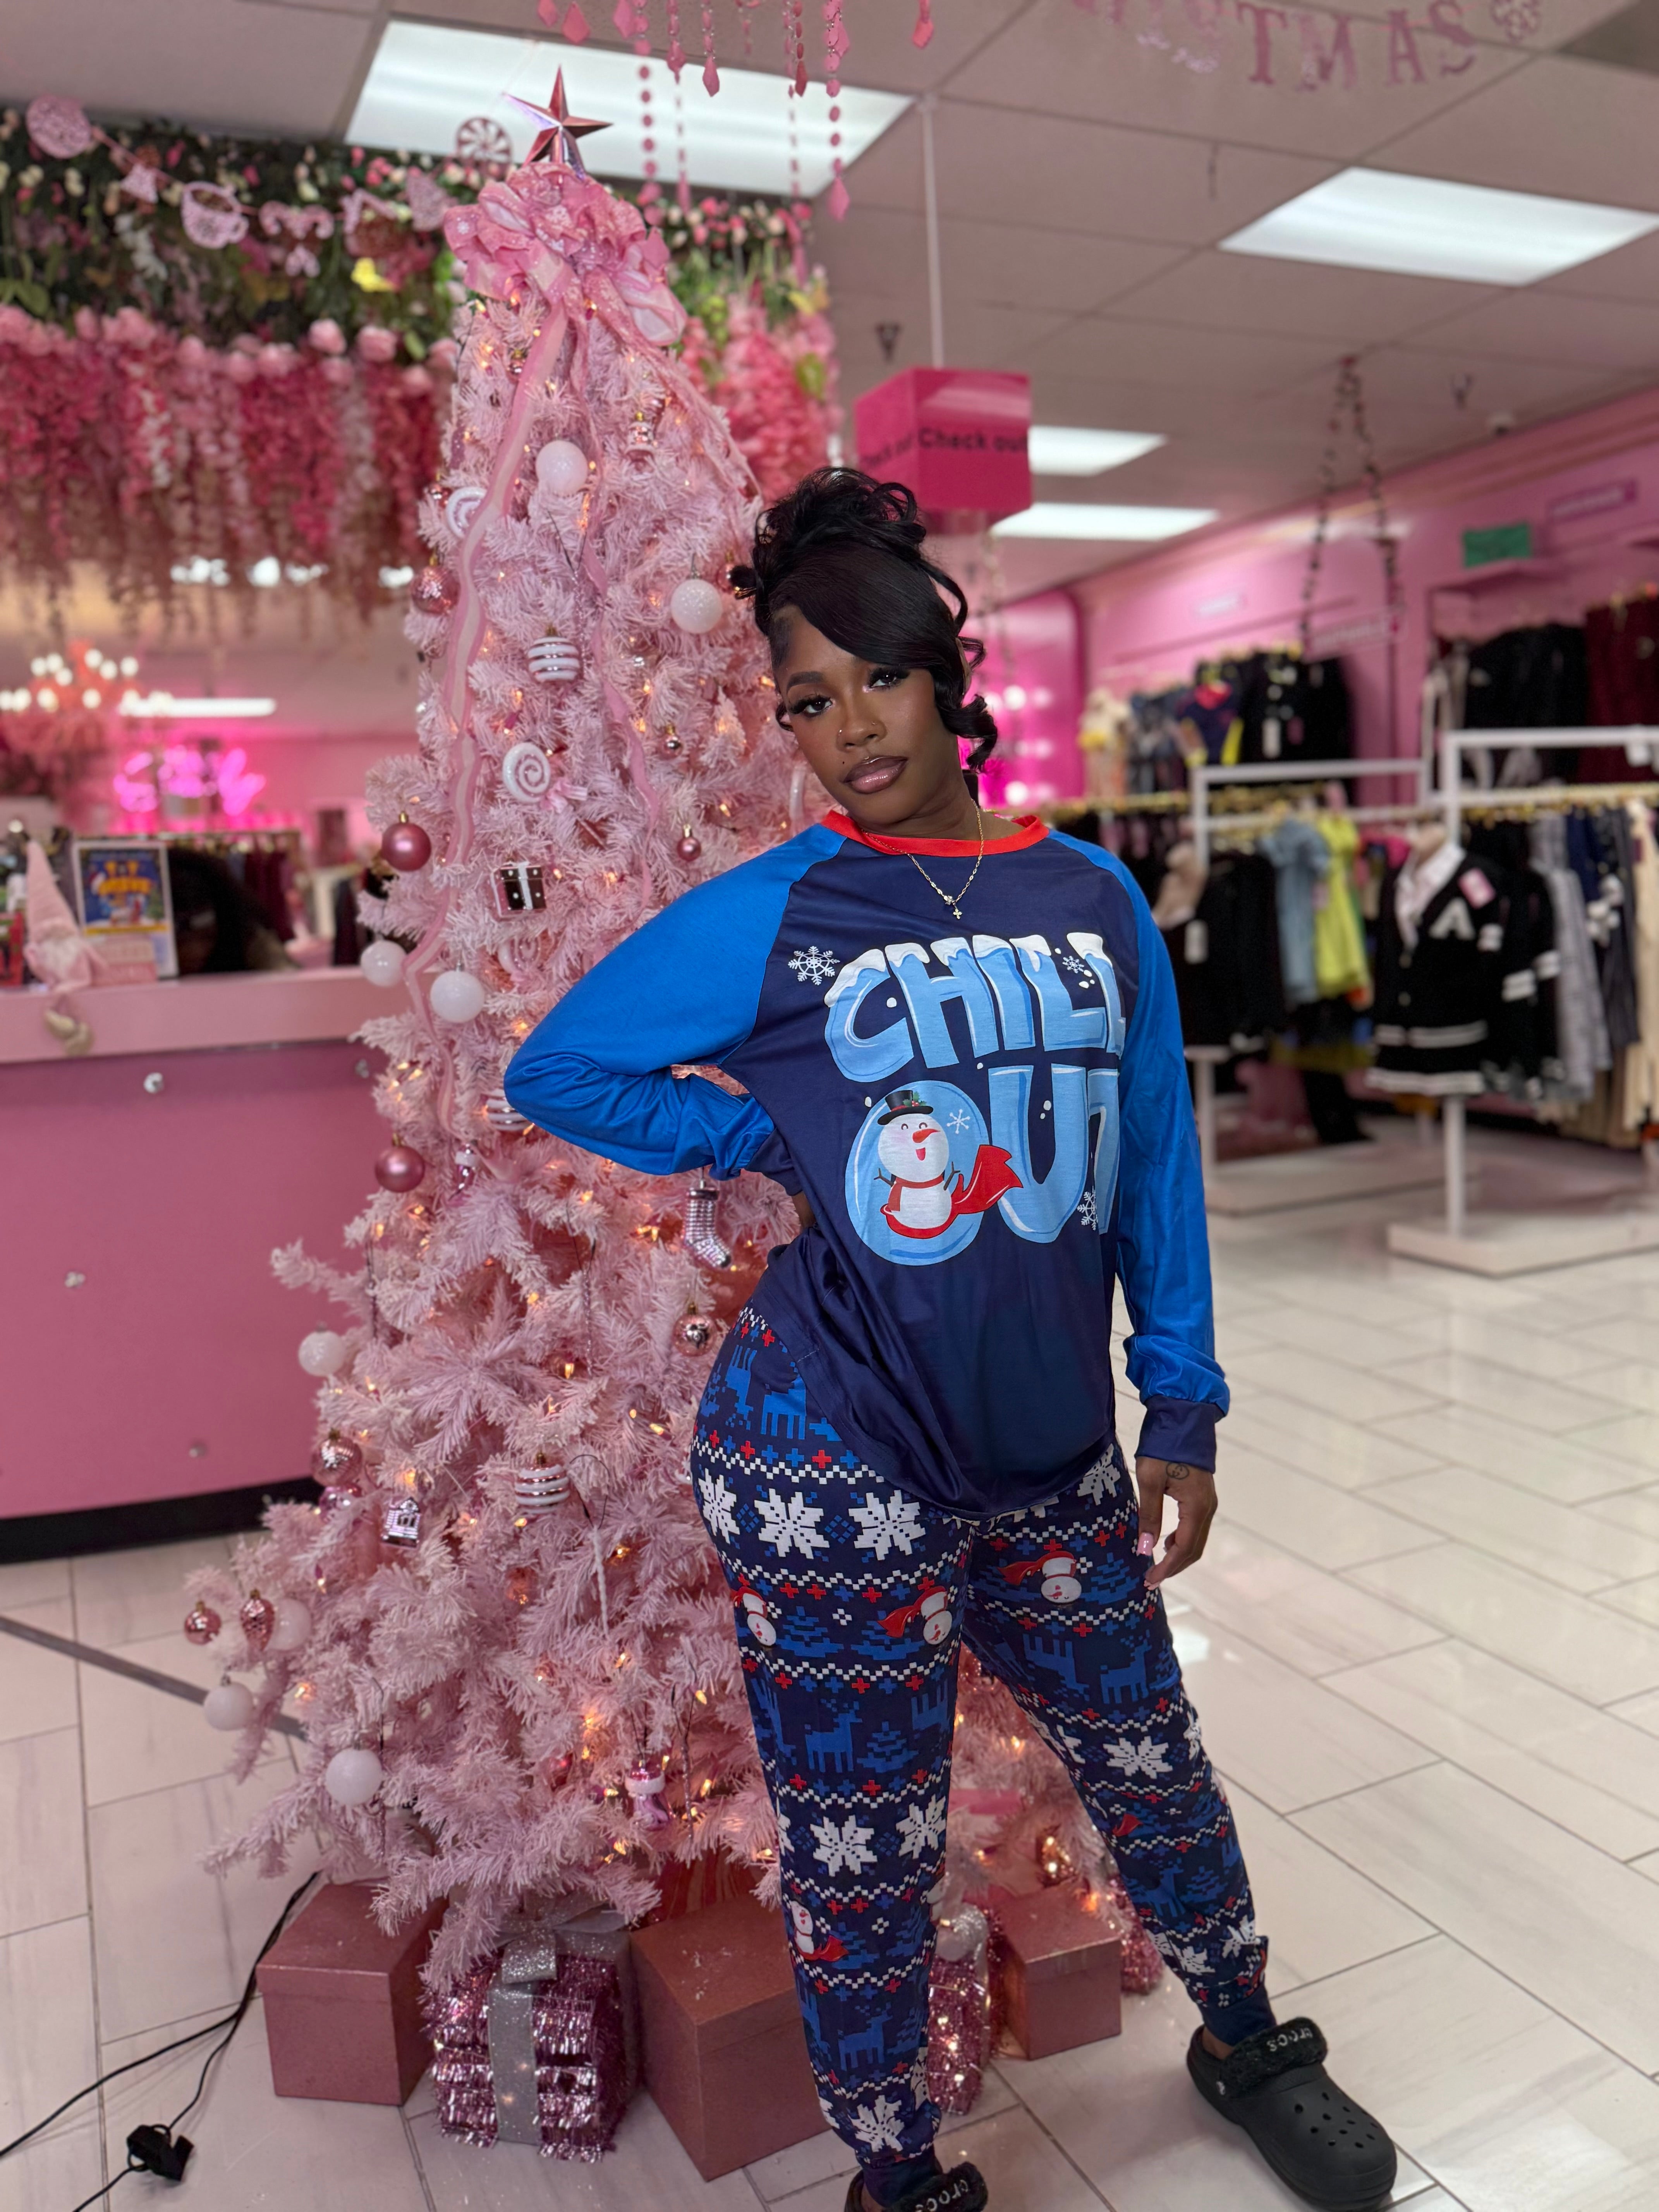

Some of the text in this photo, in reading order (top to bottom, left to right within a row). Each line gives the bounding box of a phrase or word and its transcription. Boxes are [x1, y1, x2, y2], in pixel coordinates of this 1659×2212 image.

[919, 428, 985, 449] Check
[824, 932, 1125, 1083] CHILL
[845, 1063, 1120, 1266] OUT
[1267, 2028, 1313, 2051] crocs
